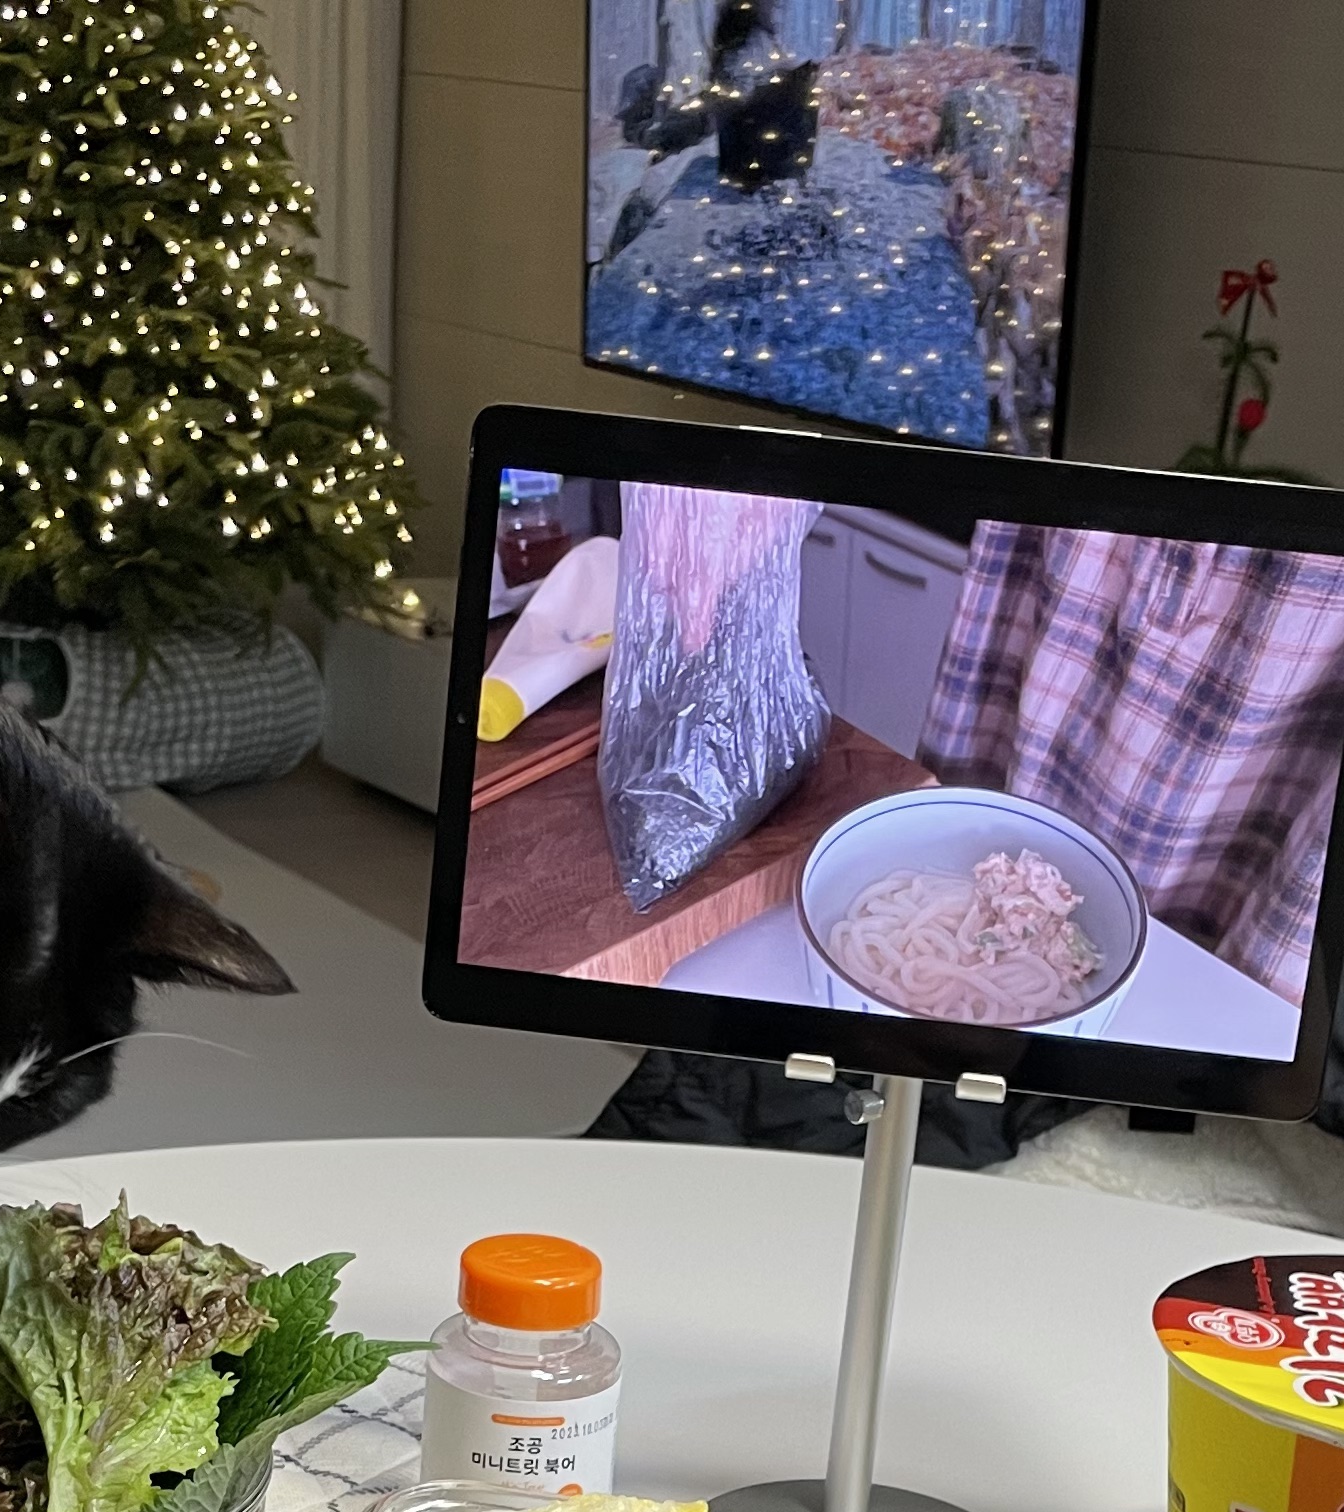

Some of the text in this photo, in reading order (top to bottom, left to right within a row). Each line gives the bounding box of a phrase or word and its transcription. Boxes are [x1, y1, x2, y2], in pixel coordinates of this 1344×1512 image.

[508, 1437, 543, 1455] 조공
[471, 1452, 575, 1476] 미니트릿 북어
